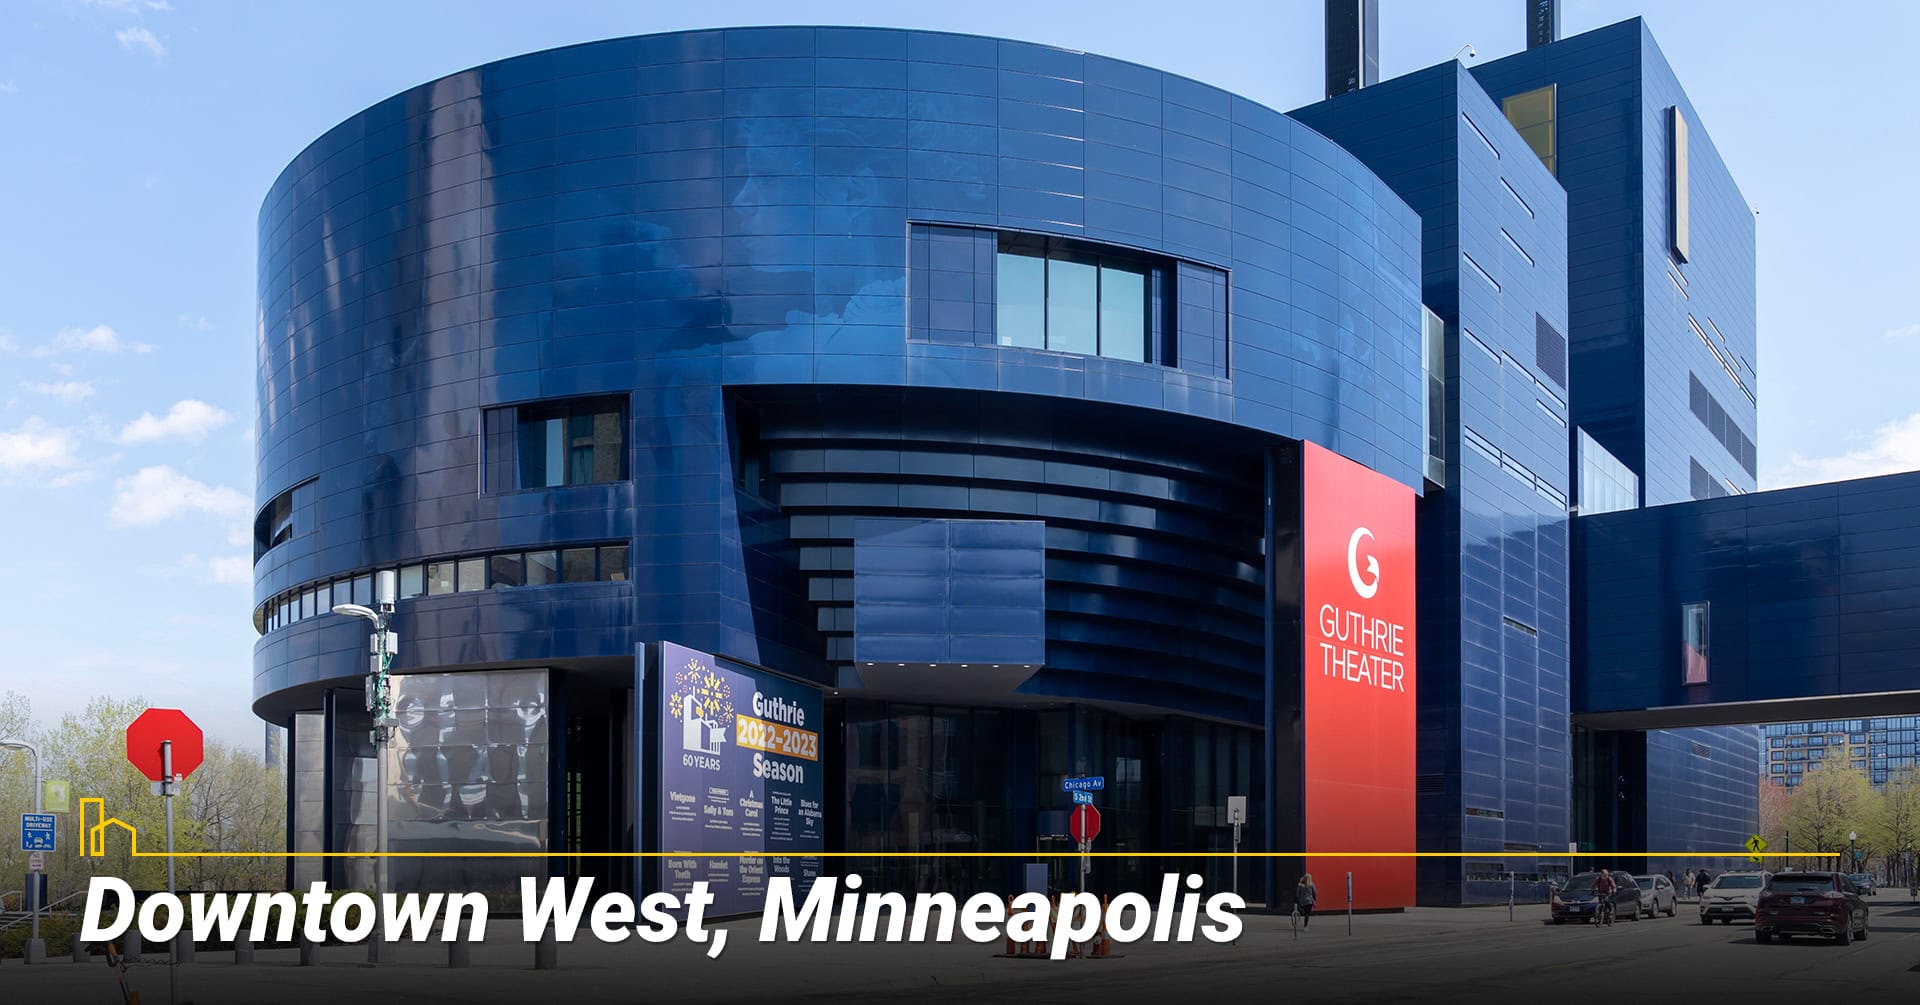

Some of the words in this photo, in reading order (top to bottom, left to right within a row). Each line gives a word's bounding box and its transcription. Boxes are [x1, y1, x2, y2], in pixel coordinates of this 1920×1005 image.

[1319, 603, 1404, 657] GUTHRIE
[1319, 642, 1405, 692] THEATER
[752, 691, 805, 726] Guthrie
[738, 719, 817, 758] 2022-2023
[682, 753, 693, 767] 60
[694, 755, 721, 772] YEARS
[752, 752, 804, 784] Season
[669, 791, 696, 804] Vietgone
[749, 789, 754, 799] A
[1064, 781, 1091, 790] Chicago
[1093, 779, 1102, 788] Av
